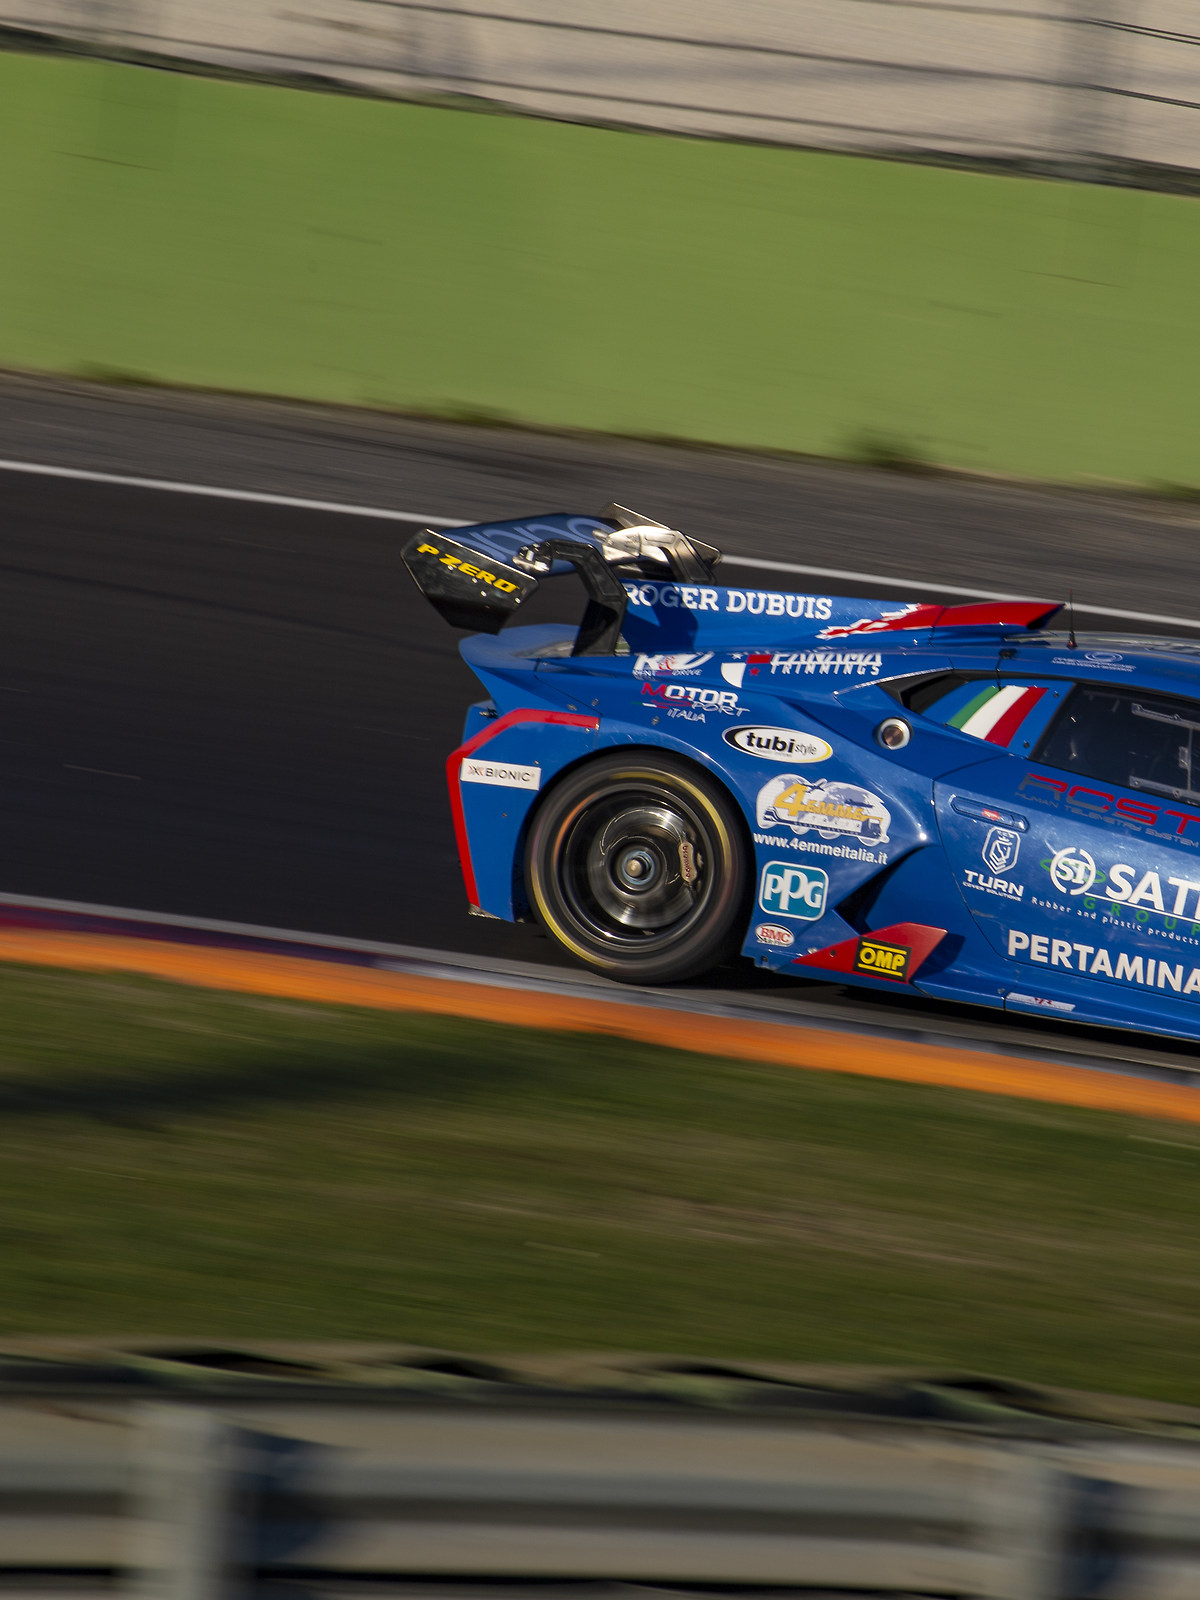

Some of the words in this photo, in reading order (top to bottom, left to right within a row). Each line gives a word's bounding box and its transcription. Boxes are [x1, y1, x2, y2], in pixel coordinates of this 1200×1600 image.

[416, 543, 440, 556] P
[439, 554, 519, 593] ZERO
[622, 583, 720, 611] ROGER
[726, 590, 833, 620] DUBUIS
[667, 707, 706, 723] ITALIA
[746, 732, 796, 753] tubi
[753, 832, 888, 865] www.4emmeitalia.it
[1145, 827, 1199, 849] SYSTEM
[763, 868, 825, 911] PPG
[964, 869, 1024, 897] TURN
[761, 927, 791, 943] BMC
[1031, 896, 1071, 913] Rubber
[1077, 908, 1097, 920] and
[1102, 915, 1142, 932] plastic
[1148, 927, 1199, 946] products
[859, 947, 906, 970] OMP
